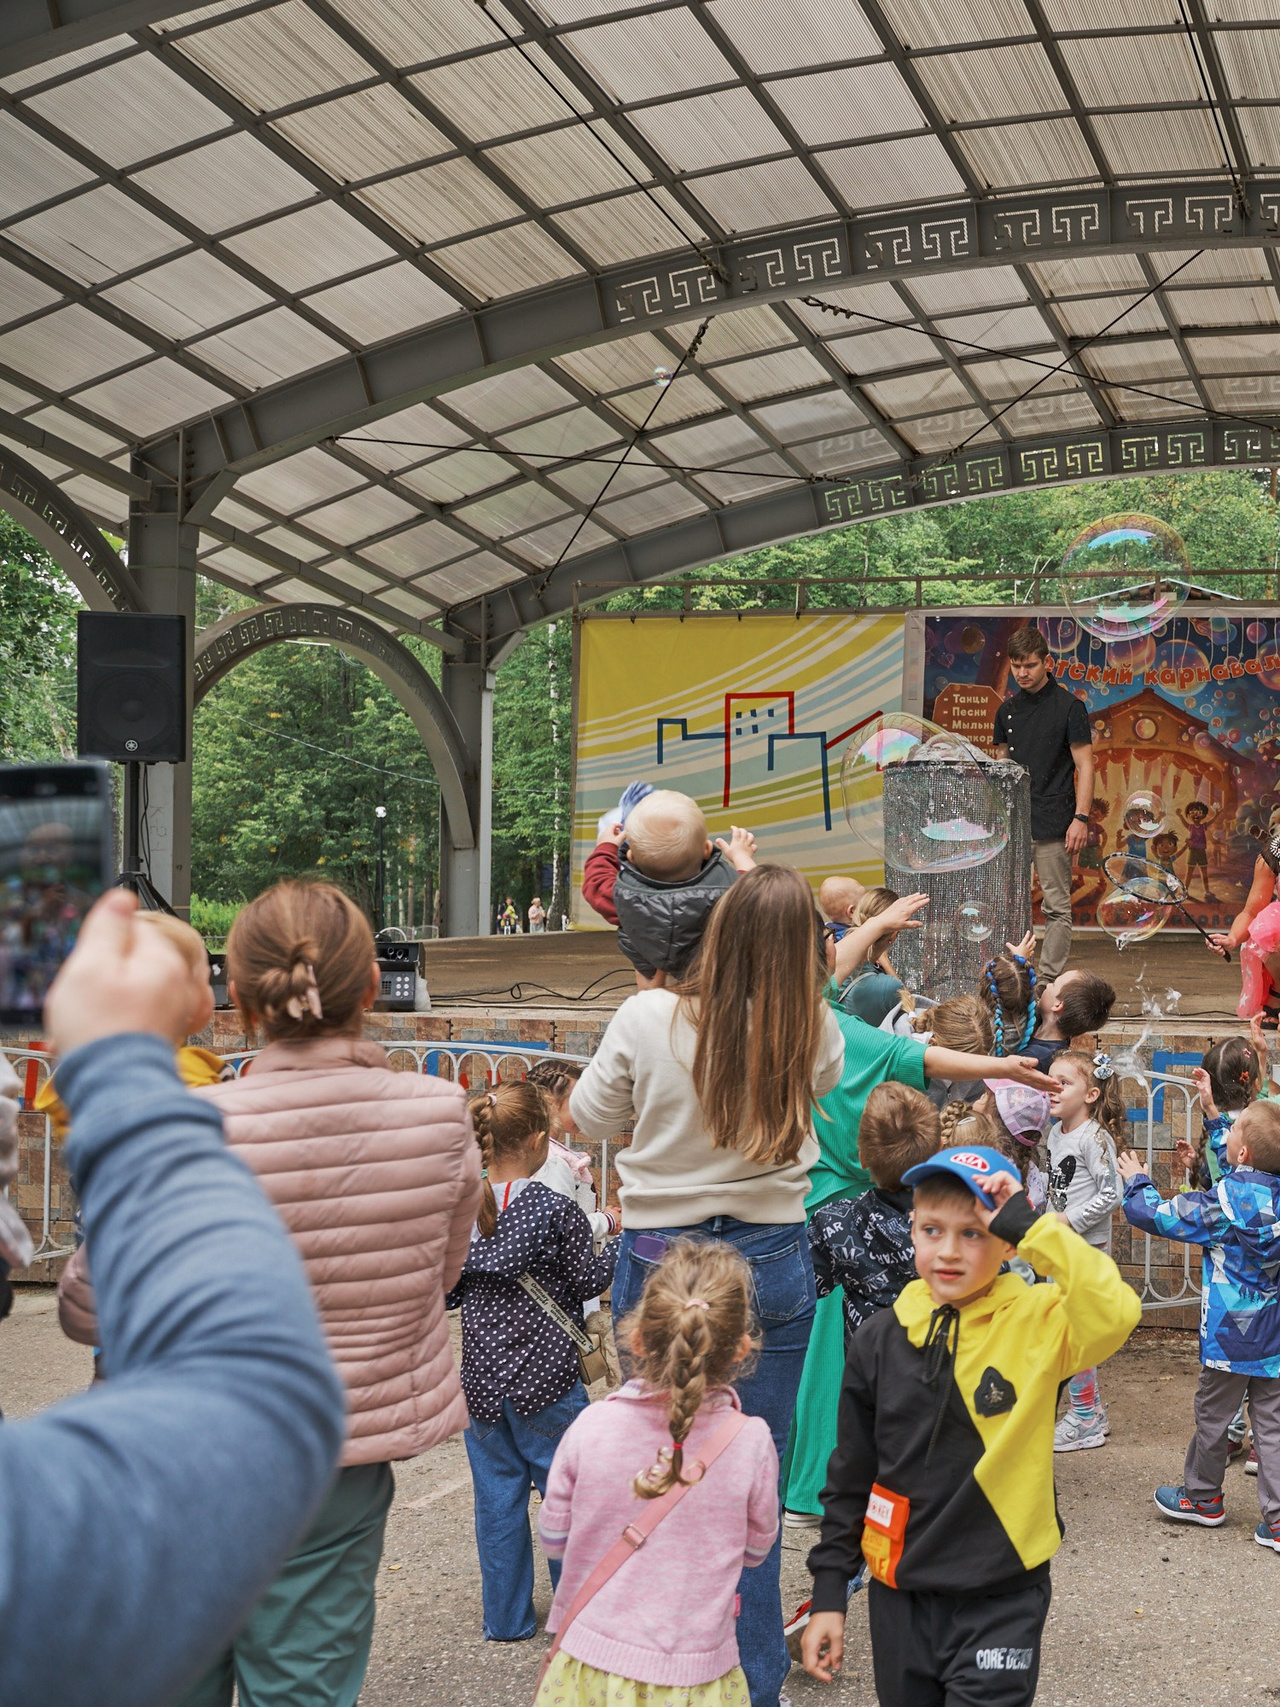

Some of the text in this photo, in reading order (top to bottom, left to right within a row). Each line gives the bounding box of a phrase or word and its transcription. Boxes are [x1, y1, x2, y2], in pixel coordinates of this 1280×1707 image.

[1045, 656, 1134, 685] етский
[952, 693, 989, 704] Танцы
[952, 706, 987, 717] Песни
[952, 1152, 986, 1171] KIA
[976, 1647, 1008, 1670] CORE
